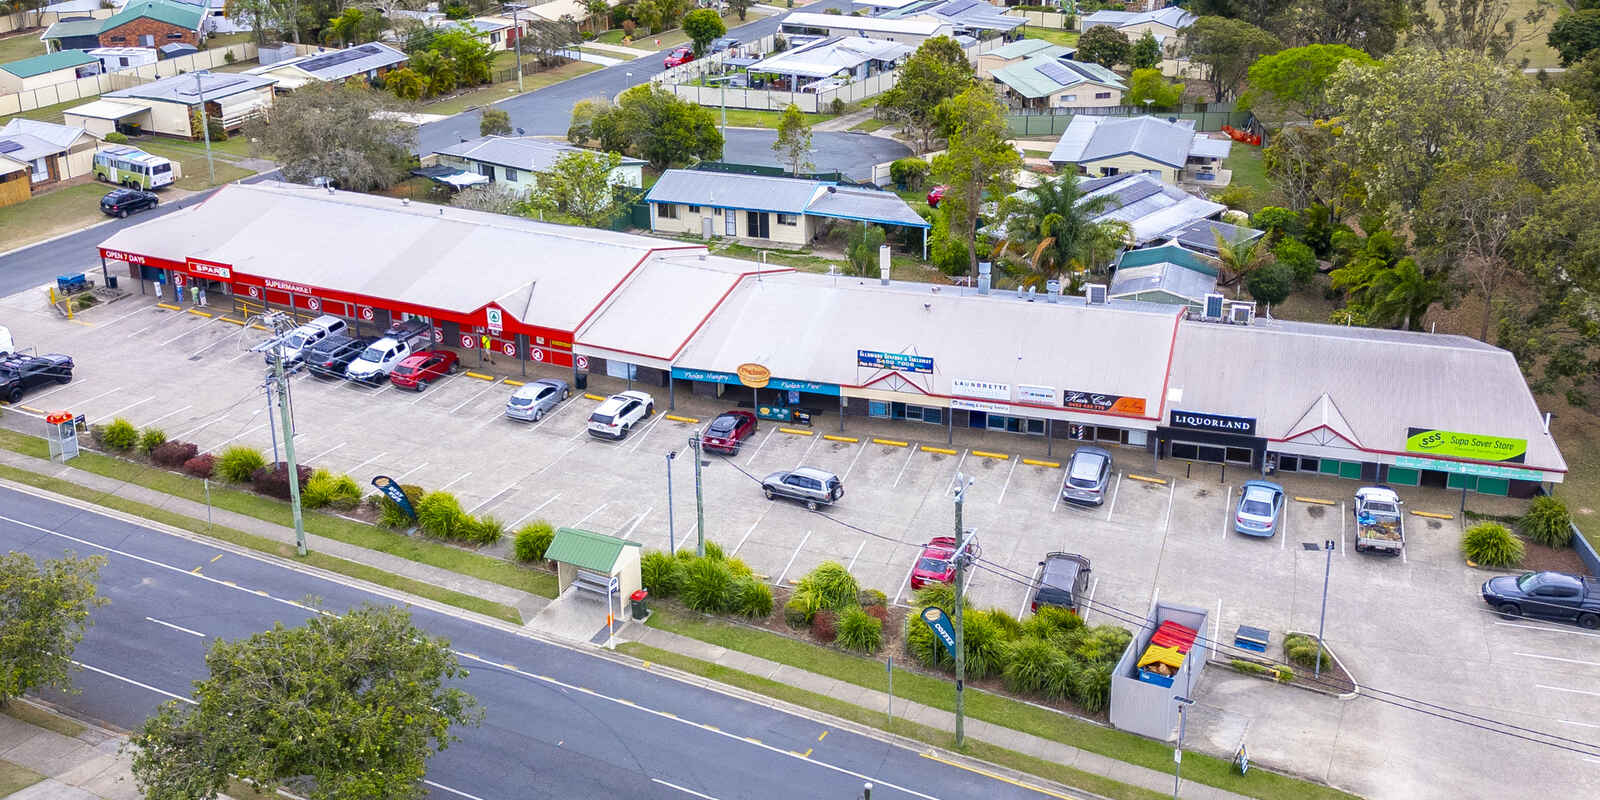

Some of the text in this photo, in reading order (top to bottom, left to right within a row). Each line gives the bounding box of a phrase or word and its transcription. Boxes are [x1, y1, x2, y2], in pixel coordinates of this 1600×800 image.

[105, 250, 123, 260] OPEN
[128, 255, 146, 264] DAYS
[196, 264, 219, 274] SPAR
[264, 279, 312, 294] SUPERMARKET
[954, 381, 1008, 391] LAUNDRETTE
[1065, 391, 1088, 403] Hair
[1090, 393, 1112, 407] Cuts
[1175, 415, 1250, 430] LIQUORLAND
[1450, 436, 1514, 451] Supa Saver Store
[934, 623, 955, 647] COFFEE
